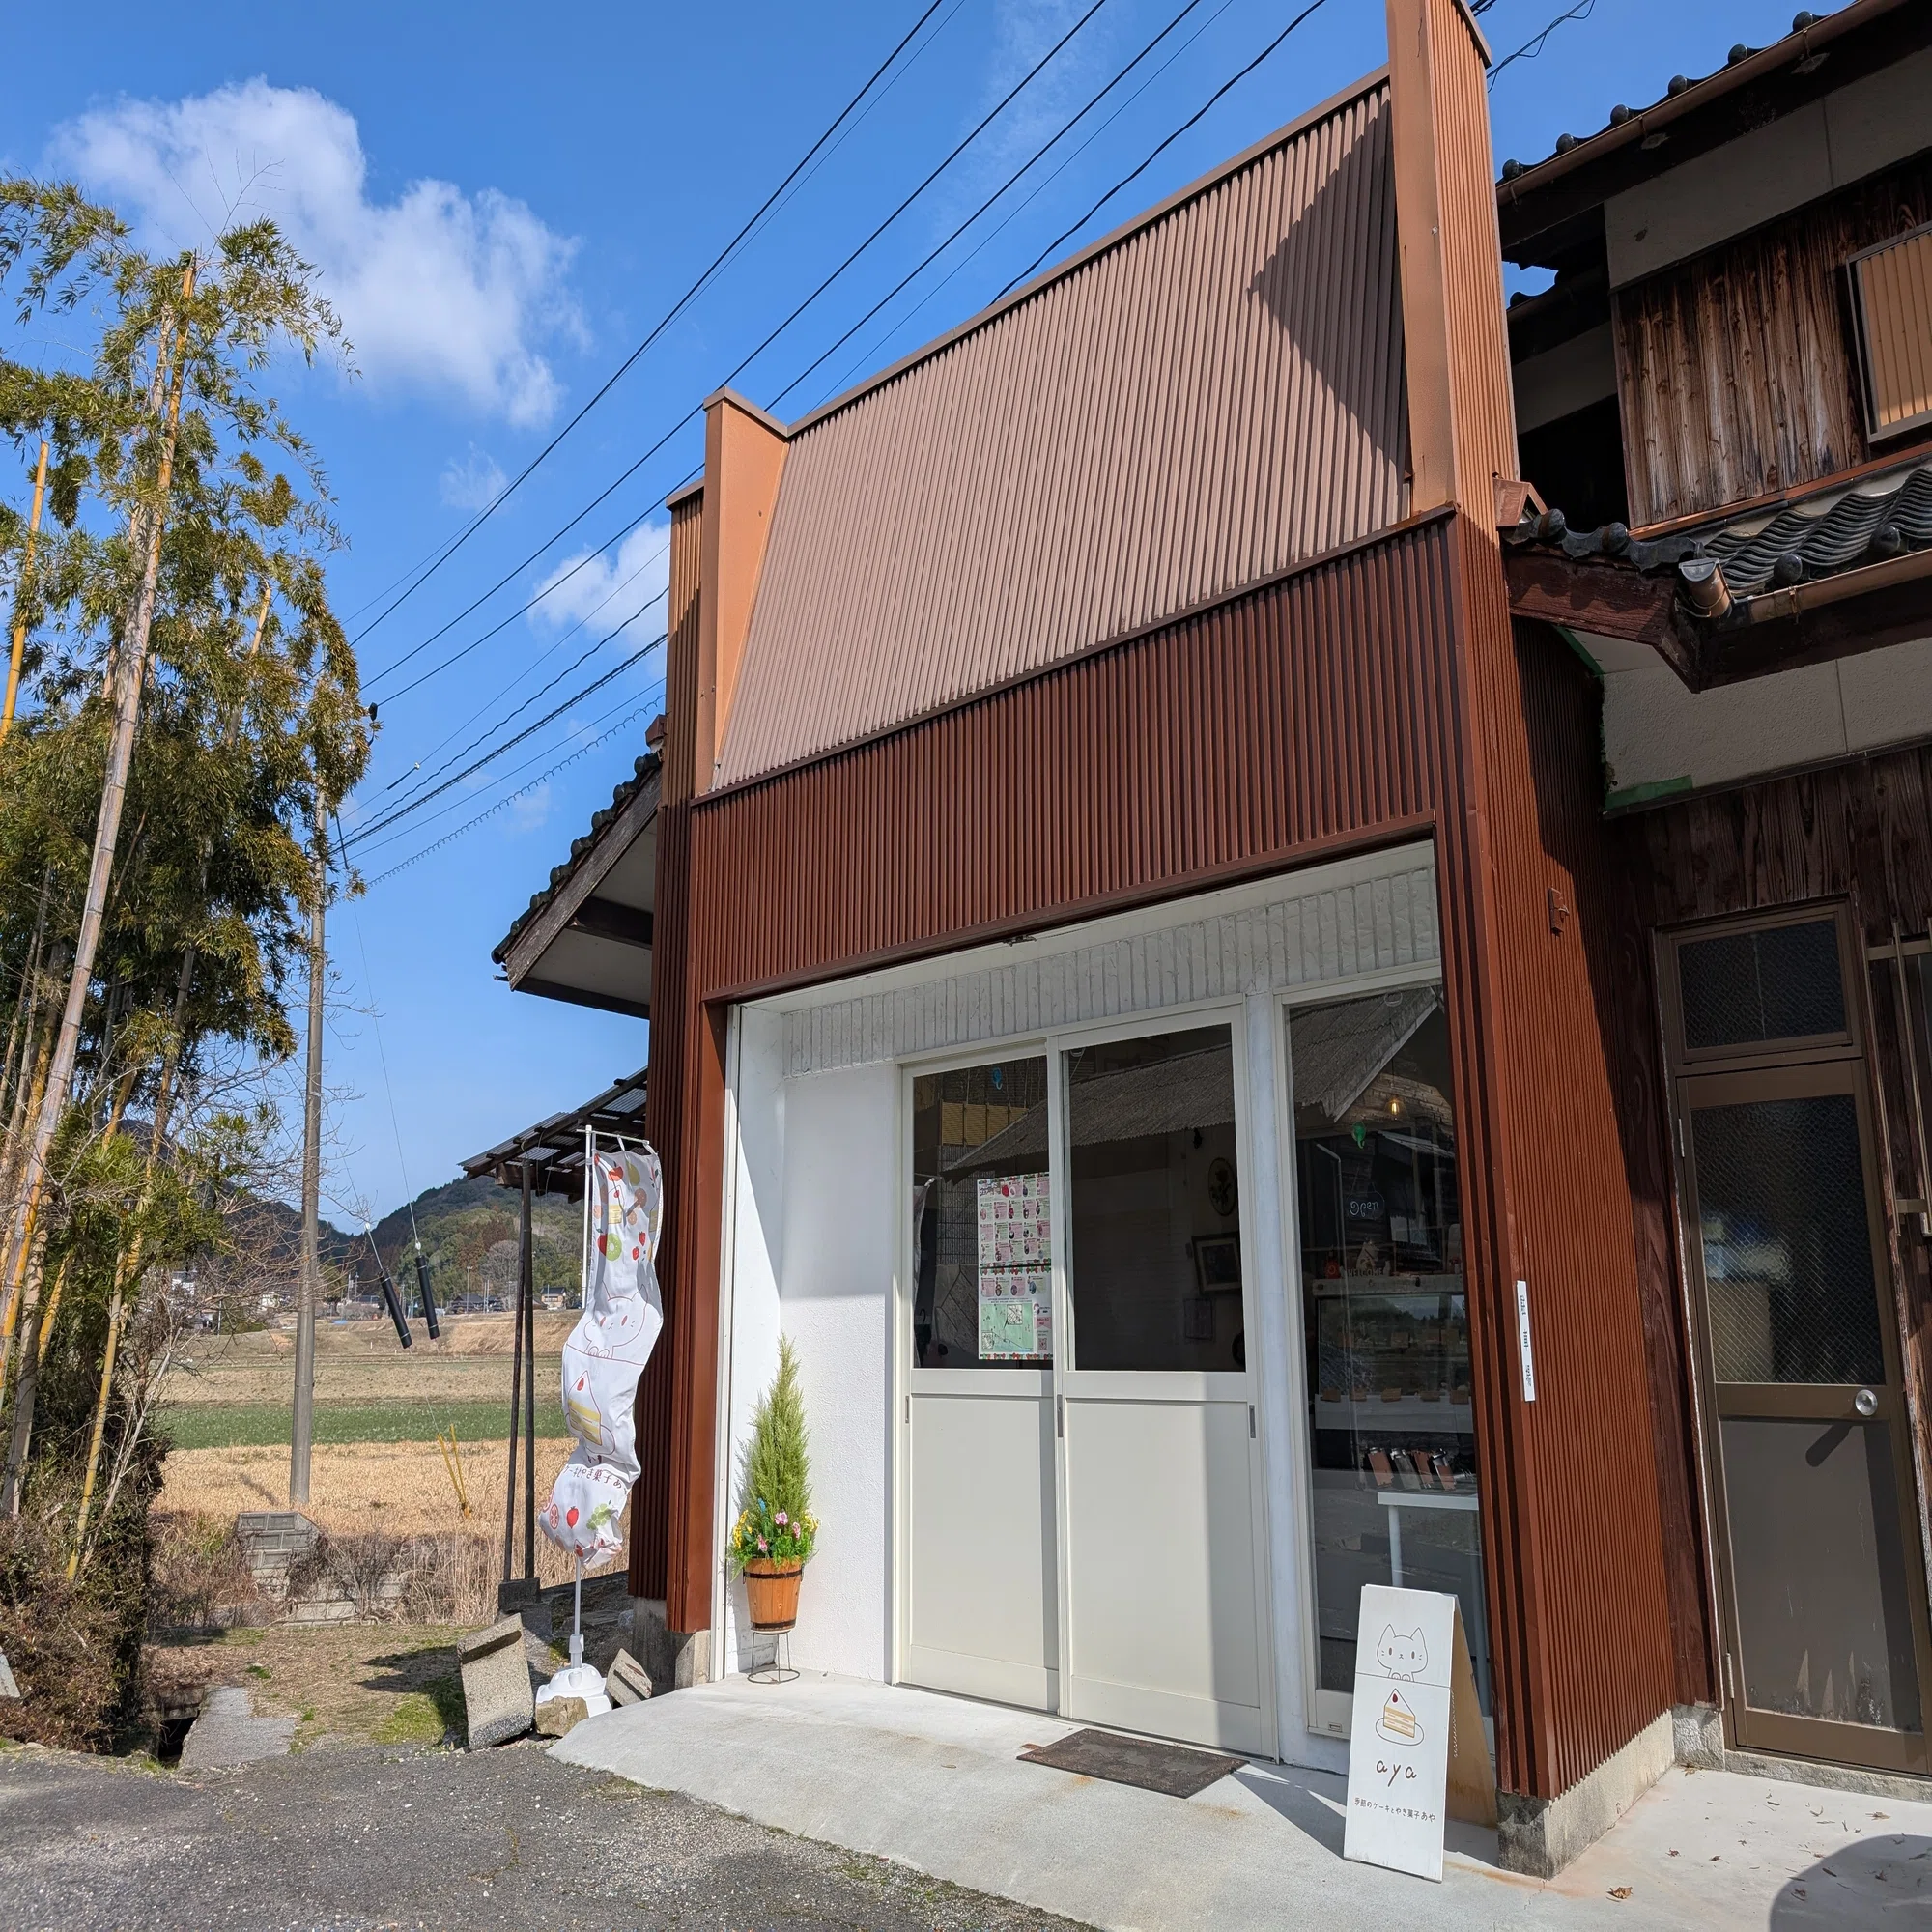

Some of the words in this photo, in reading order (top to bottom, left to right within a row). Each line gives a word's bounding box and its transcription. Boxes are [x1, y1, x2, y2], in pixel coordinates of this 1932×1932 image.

[1349, 1201, 1379, 1217] Open
[1347, 1267, 1384, 1277] WELCOME
[1376, 1759, 1417, 1787] aya
[1354, 1797, 1435, 1823] 季節のケーキとやき菓子あや
